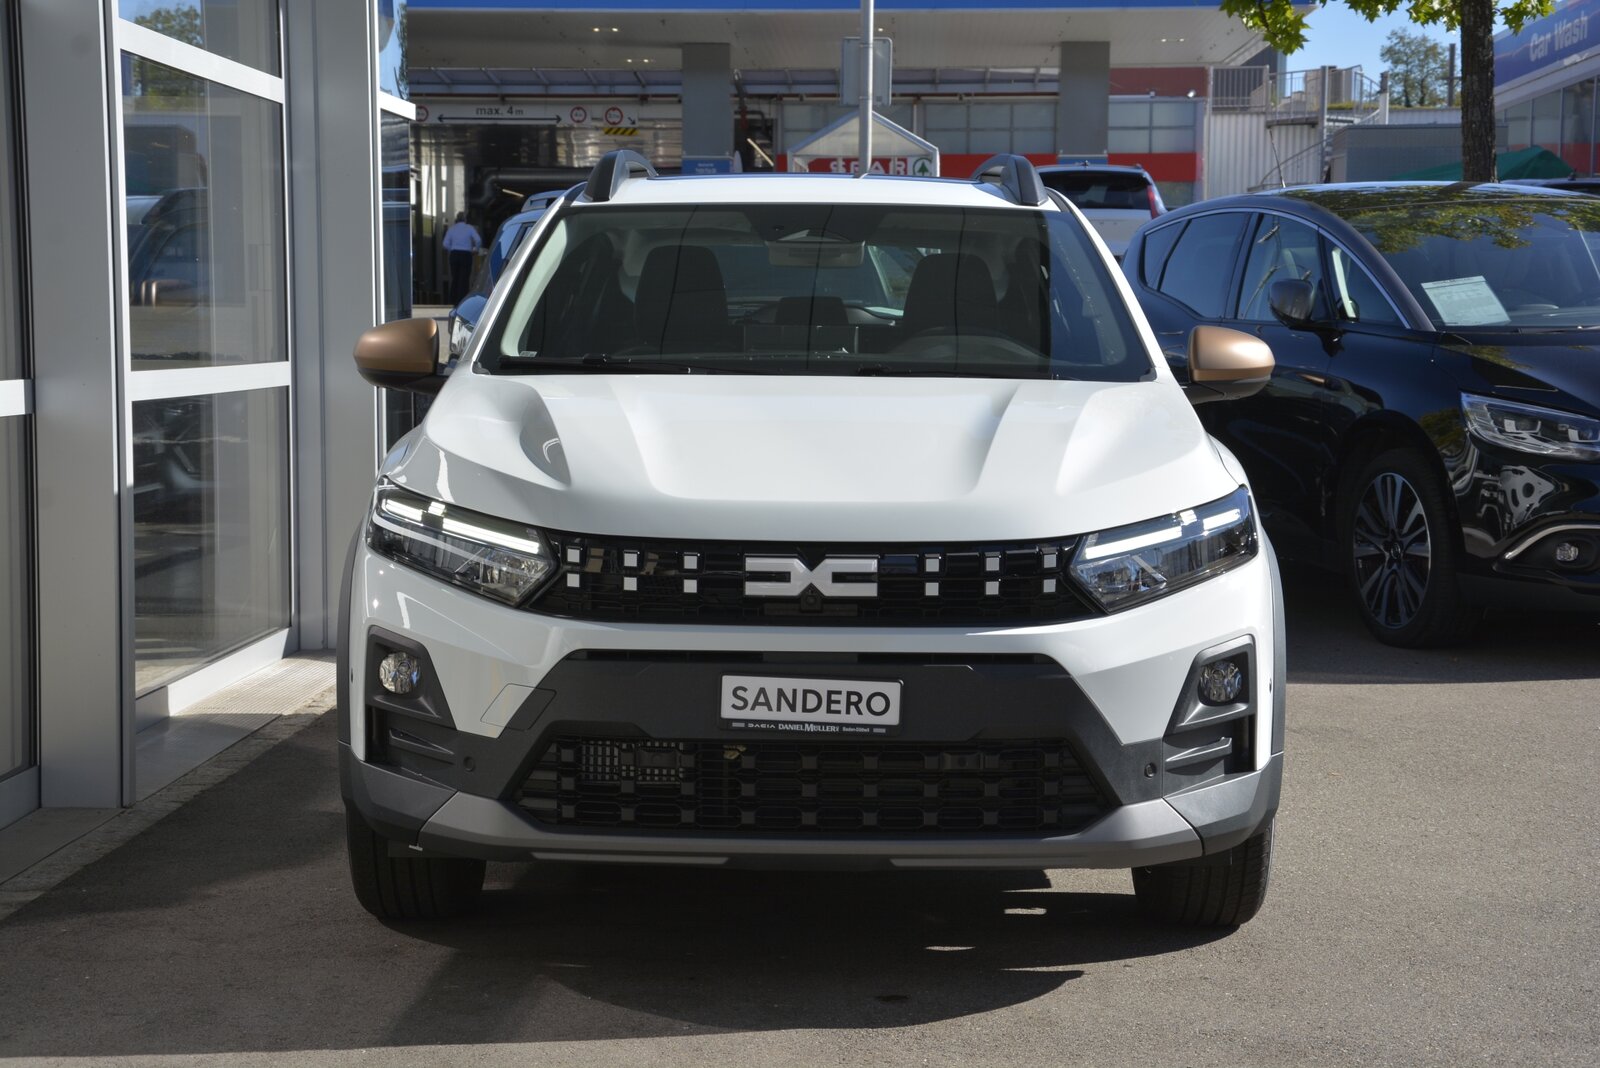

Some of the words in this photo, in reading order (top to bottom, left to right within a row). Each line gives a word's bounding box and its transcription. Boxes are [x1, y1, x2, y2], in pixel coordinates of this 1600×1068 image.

[1529, 31, 1551, 62] Car
[1554, 10, 1588, 52] Wash
[730, 685, 891, 717] SANDERO
